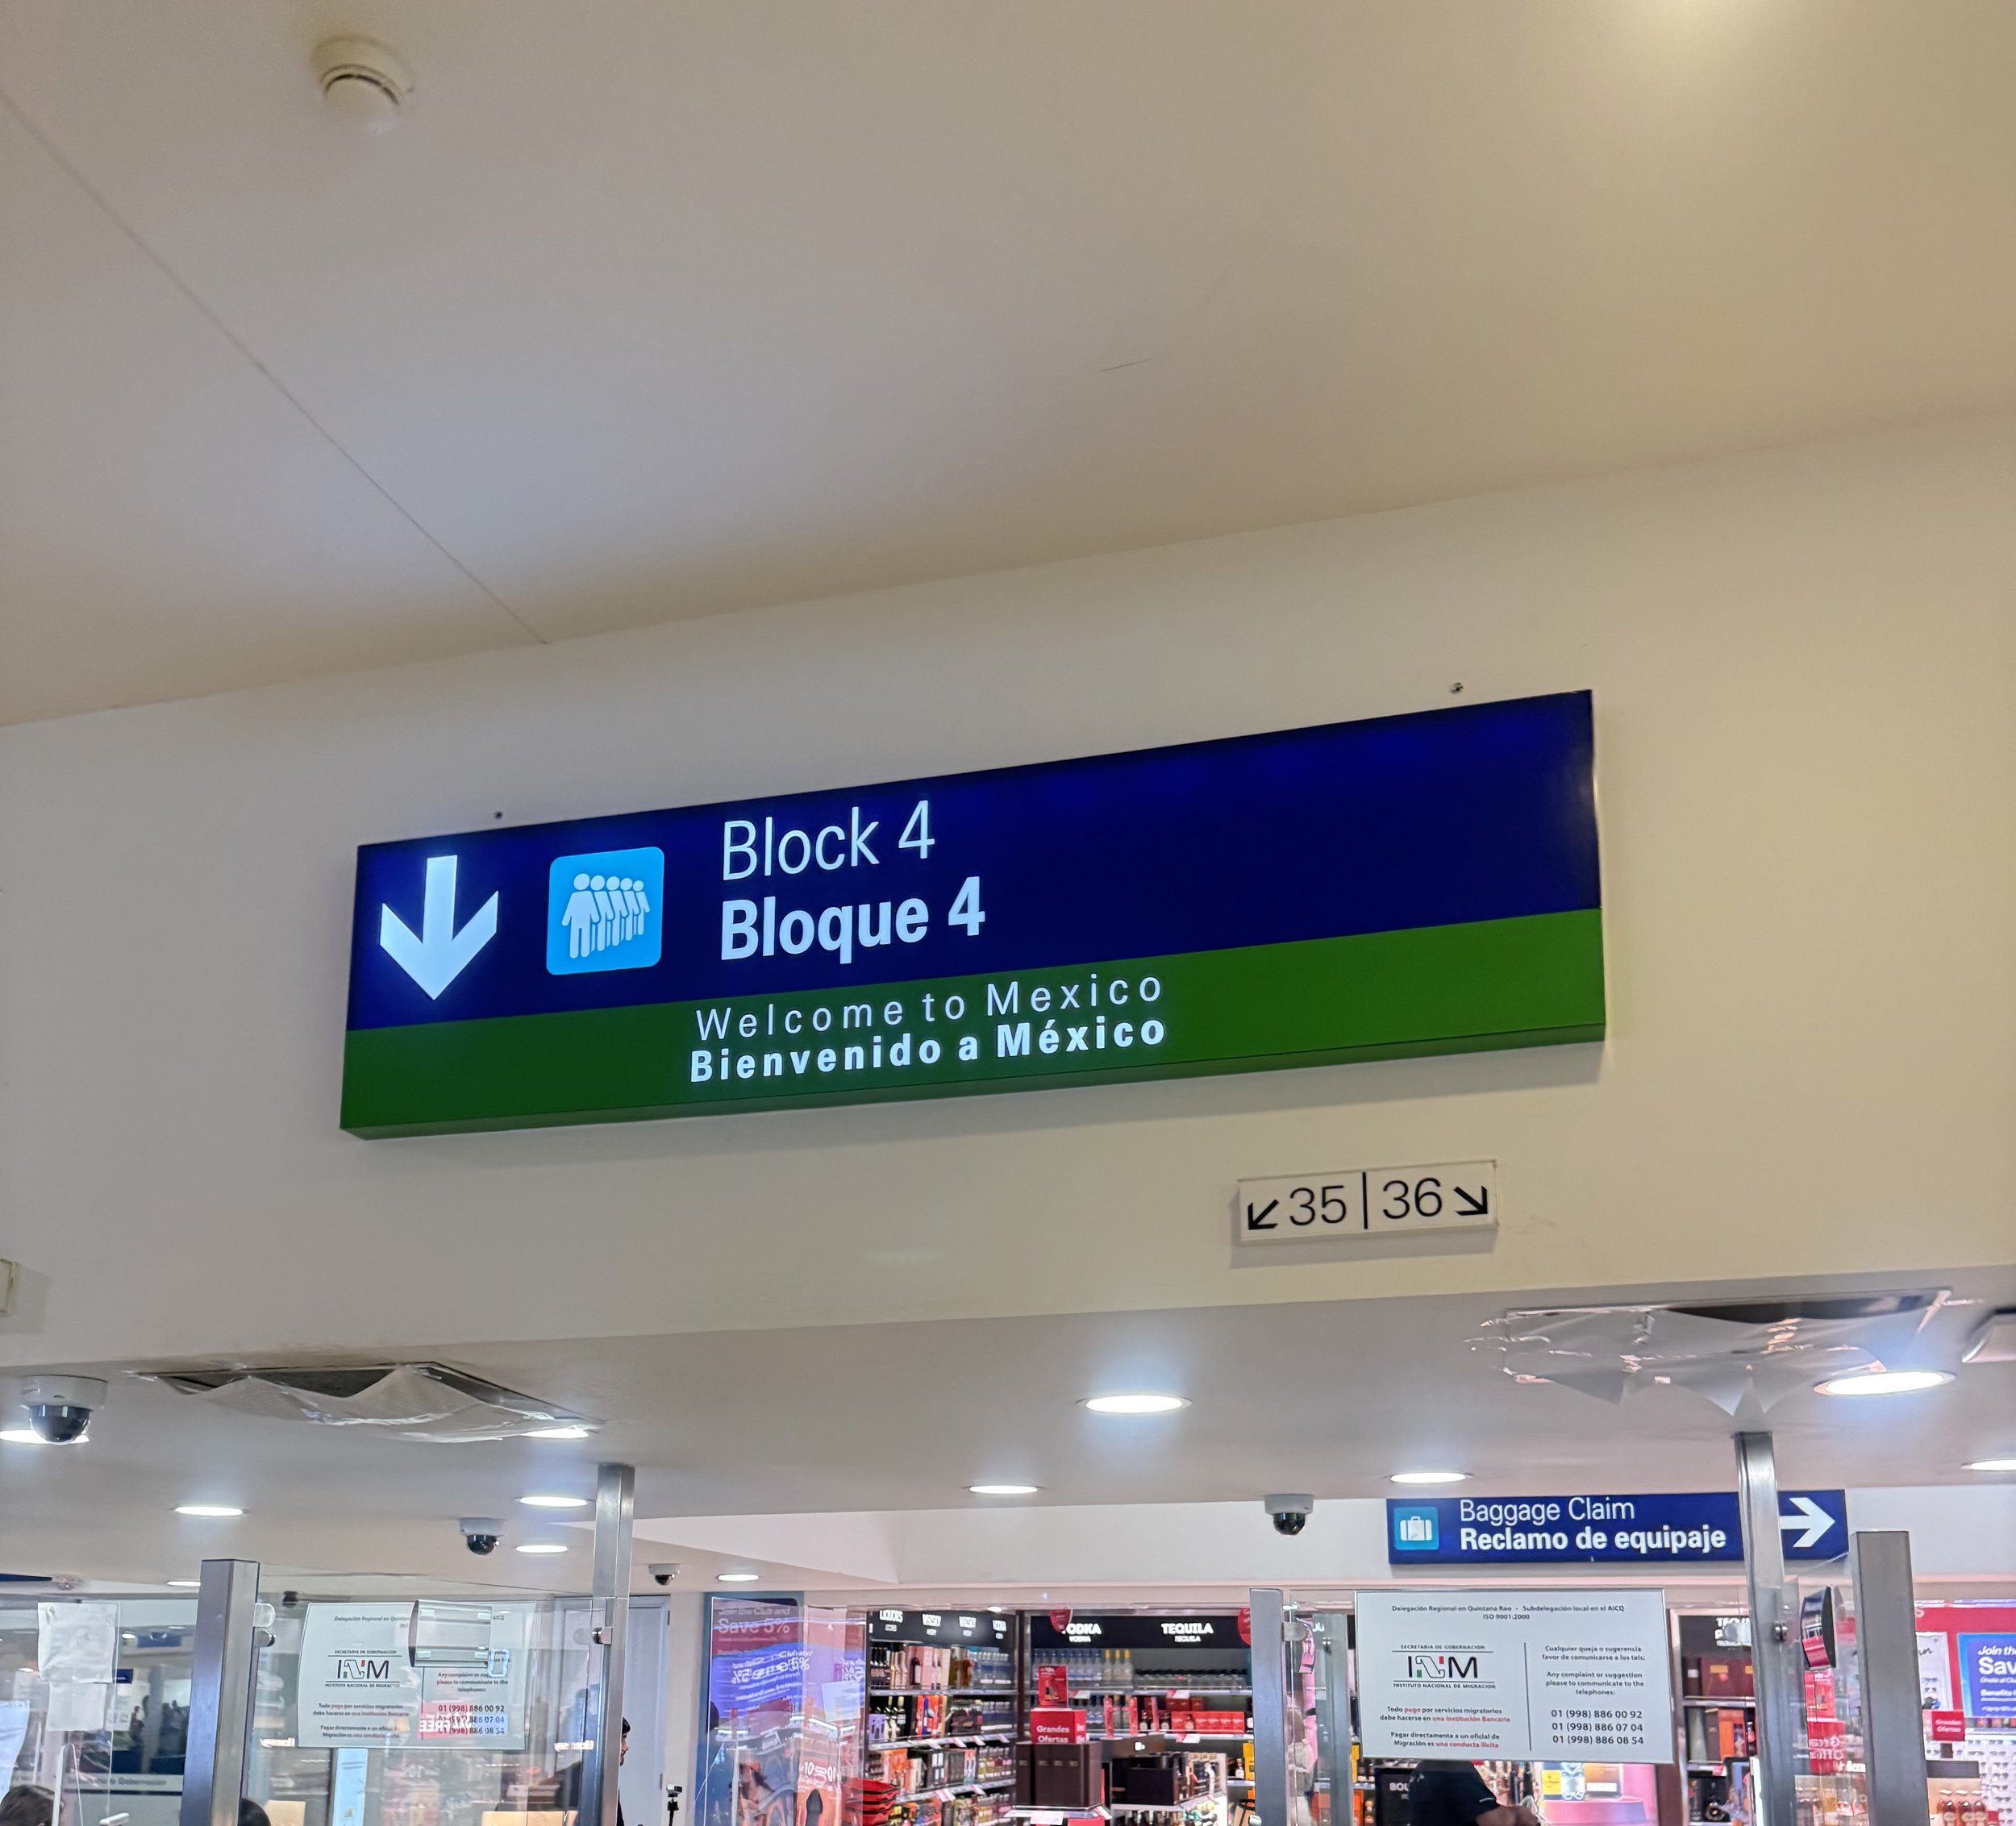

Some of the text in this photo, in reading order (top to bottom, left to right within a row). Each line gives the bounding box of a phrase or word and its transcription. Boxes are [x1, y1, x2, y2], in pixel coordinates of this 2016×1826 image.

[723, 801, 935, 880] Block 4
[721, 876, 985, 964] Bloque 4
[696, 974, 1161, 1041] Welcome to Mexico
[690, 1016, 1164, 1082] Bienvenido a México
[1289, 1185, 1347, 1225] 35
[1382, 1178, 1442, 1219] 36
[1460, 1496, 1635, 1525] Baggage Claim
[1460, 1524, 1727, 1554] Reclamo de equipaje
[1061, 1623, 1102, 1634] ODKA
[1160, 1623, 1214, 1634] TEQUILA
[1977, 1645, 2002, 1656] Join
[1551, 1709, 1643, 1719] 01 (998) 886 00 92
[1552, 1722, 1643, 1732] 01 (998) 886 07 04
[1037, 1735, 1069, 1743] Ofertas
[1552, 1735, 1644, 1745] 01 (998) 886 08 54
